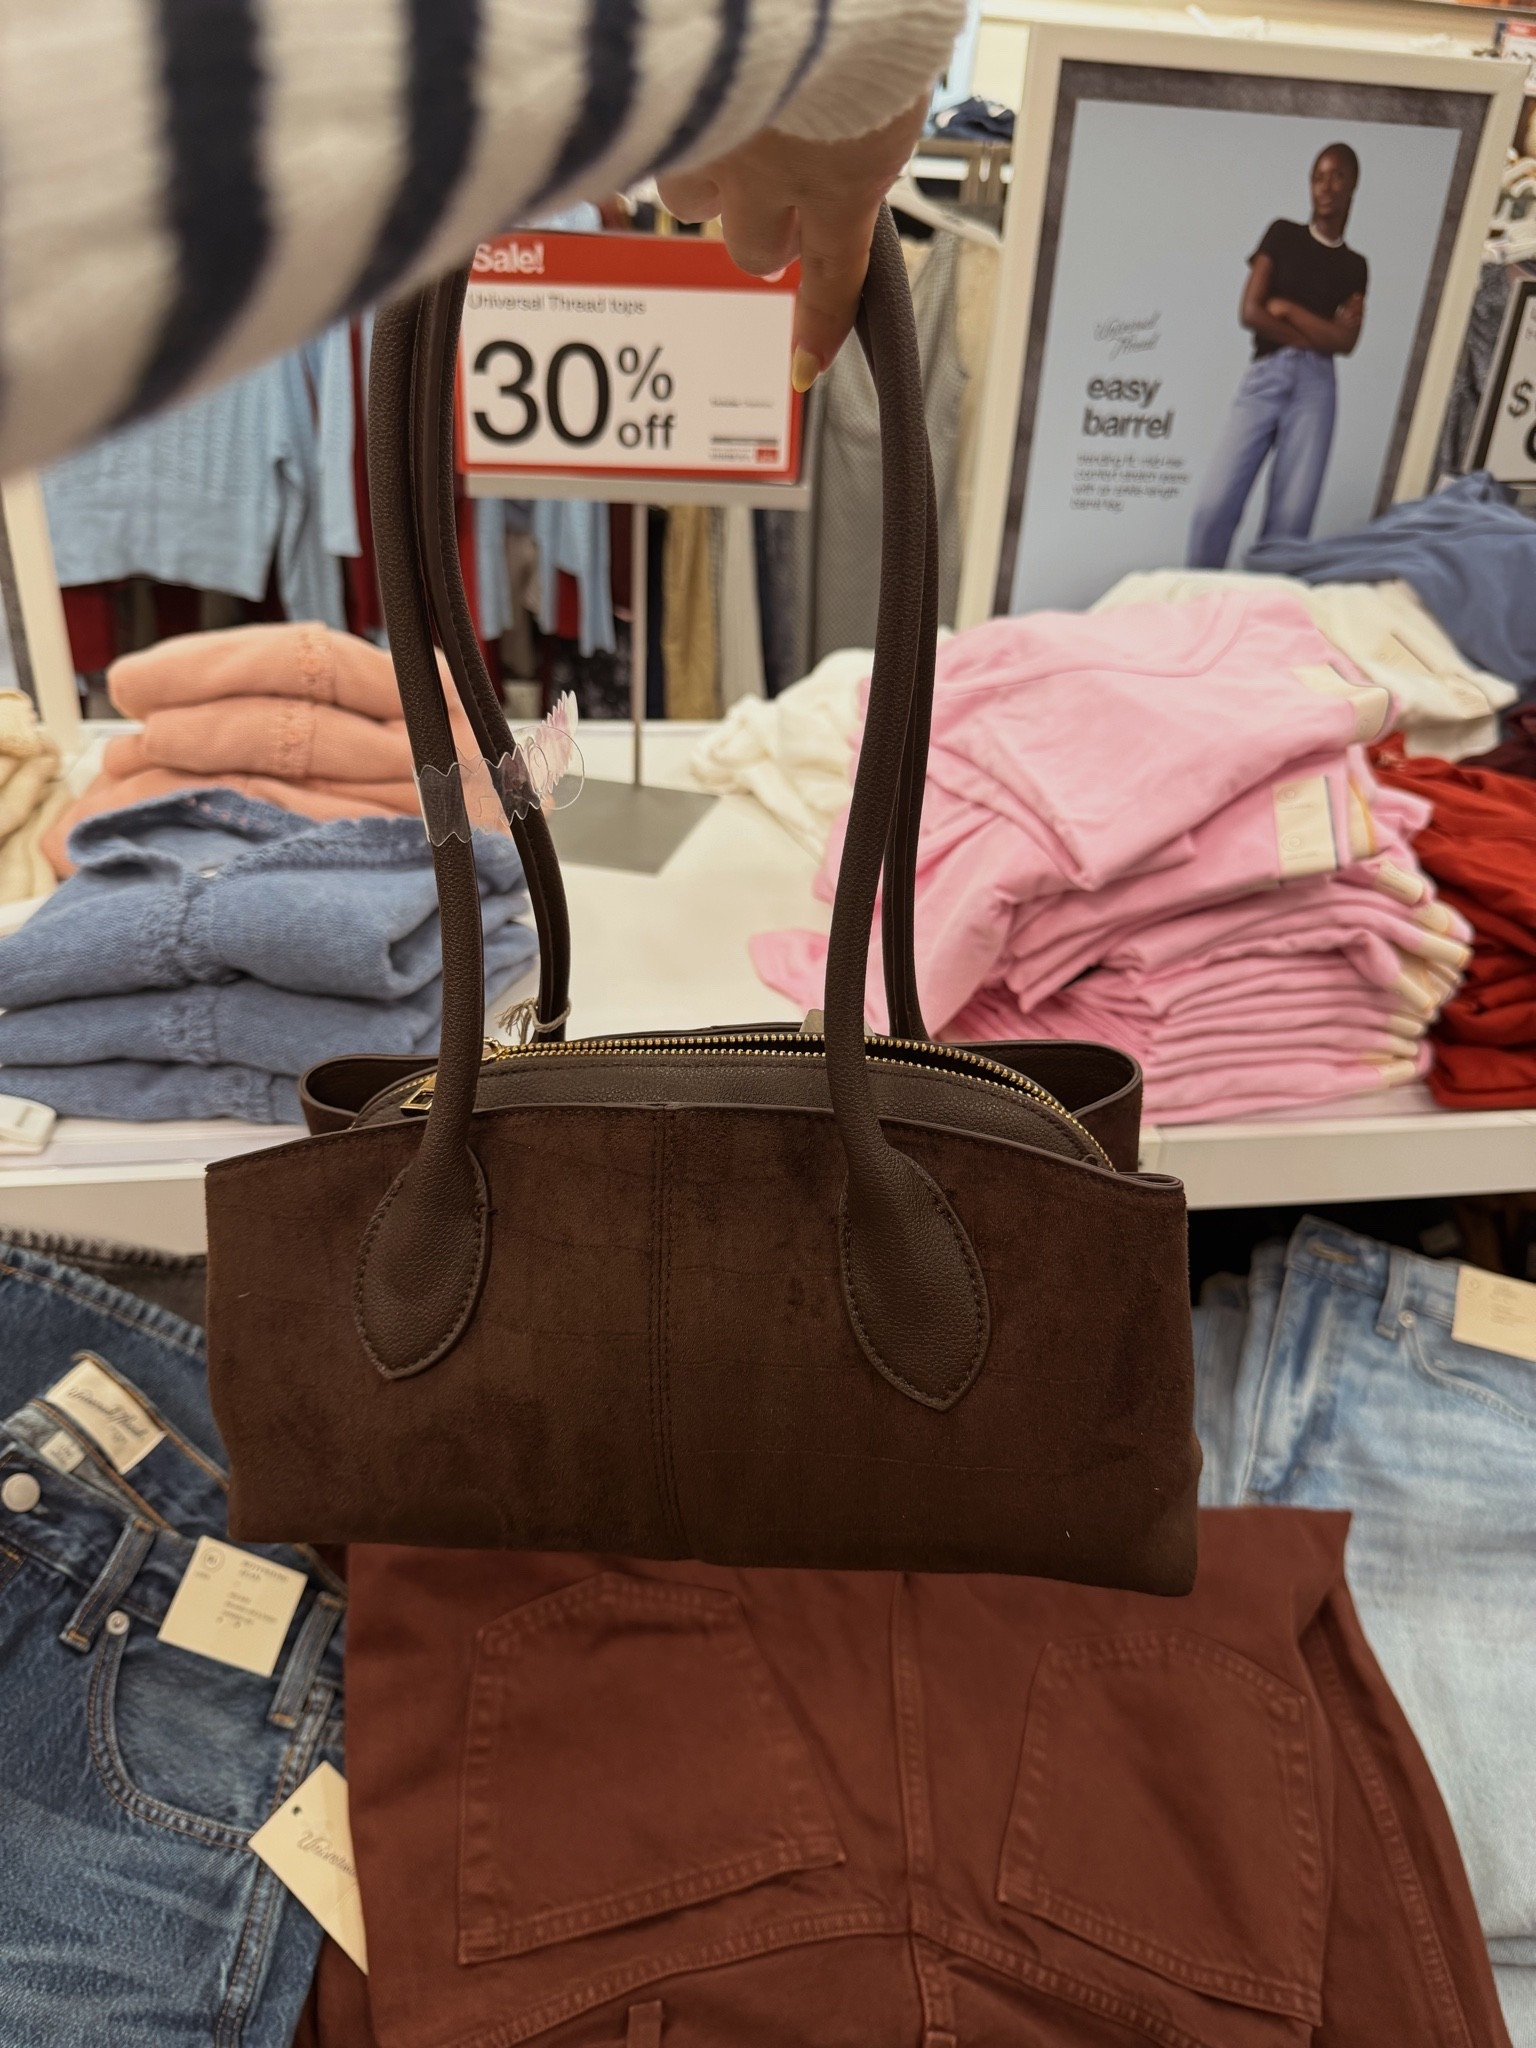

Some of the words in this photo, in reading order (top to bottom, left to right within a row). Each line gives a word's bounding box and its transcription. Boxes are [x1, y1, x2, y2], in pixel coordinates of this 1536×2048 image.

[472, 241, 545, 274] Sale!
[467, 291, 545, 311] Universal
[549, 293, 606, 314] Thread
[609, 296, 647, 316] tops
[1087, 376, 1162, 408] easy
[618, 414, 675, 449] off
[1082, 407, 1175, 438] barrel
